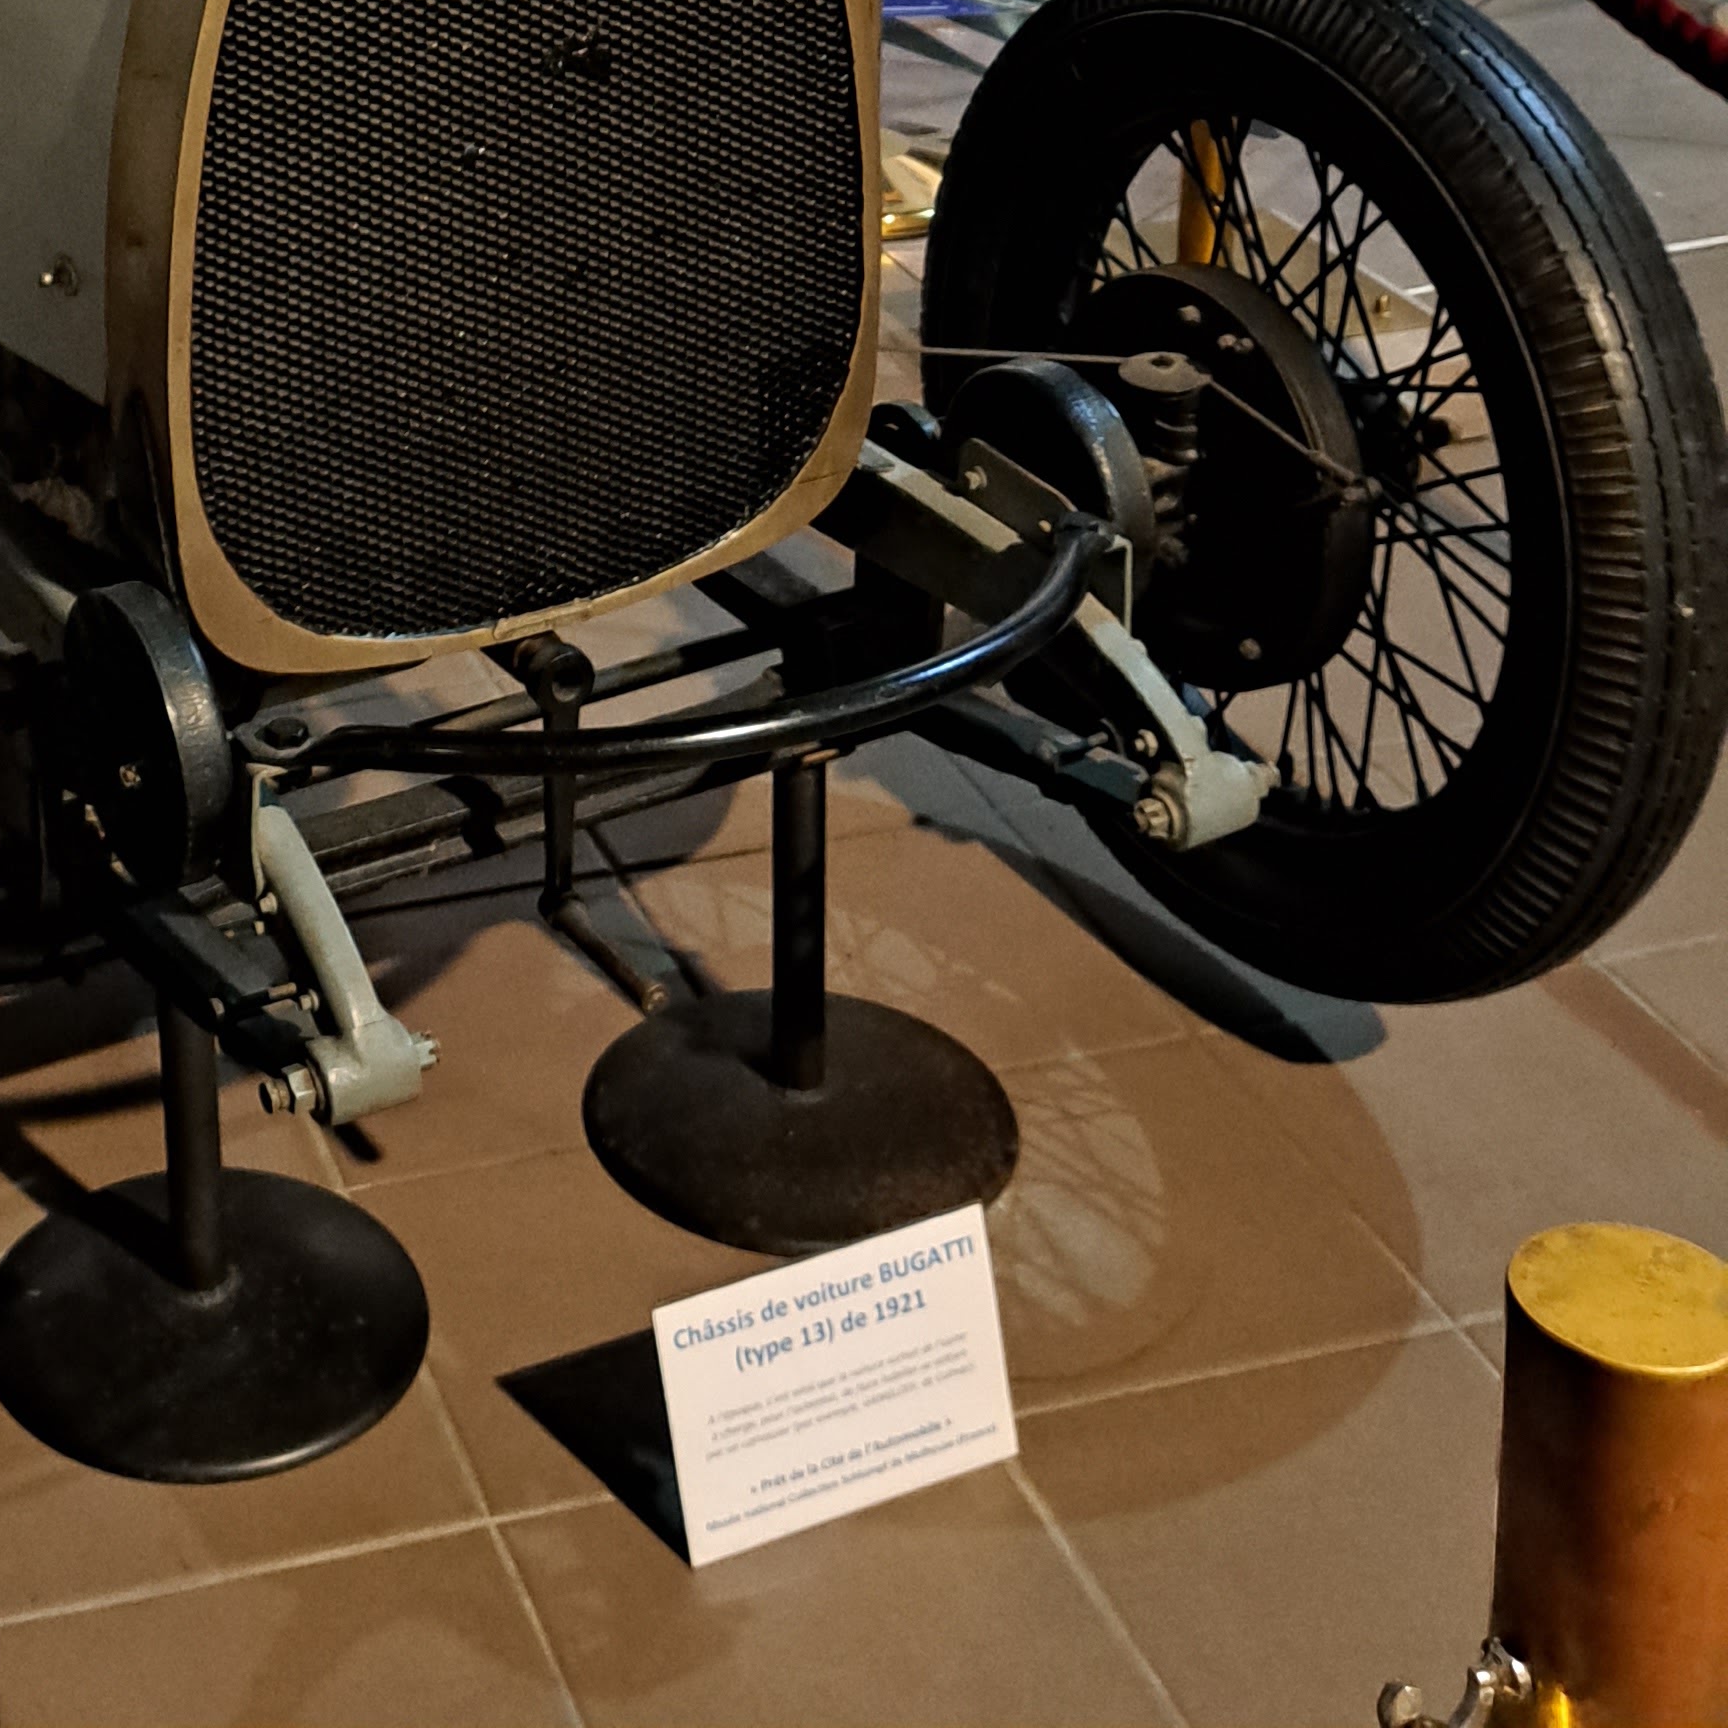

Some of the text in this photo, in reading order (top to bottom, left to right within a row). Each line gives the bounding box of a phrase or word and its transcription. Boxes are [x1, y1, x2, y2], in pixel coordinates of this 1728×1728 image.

[672, 1233, 974, 1351] Châssis de voiture BUGATTI
[734, 1287, 926, 1373] (type 13) de 1921
